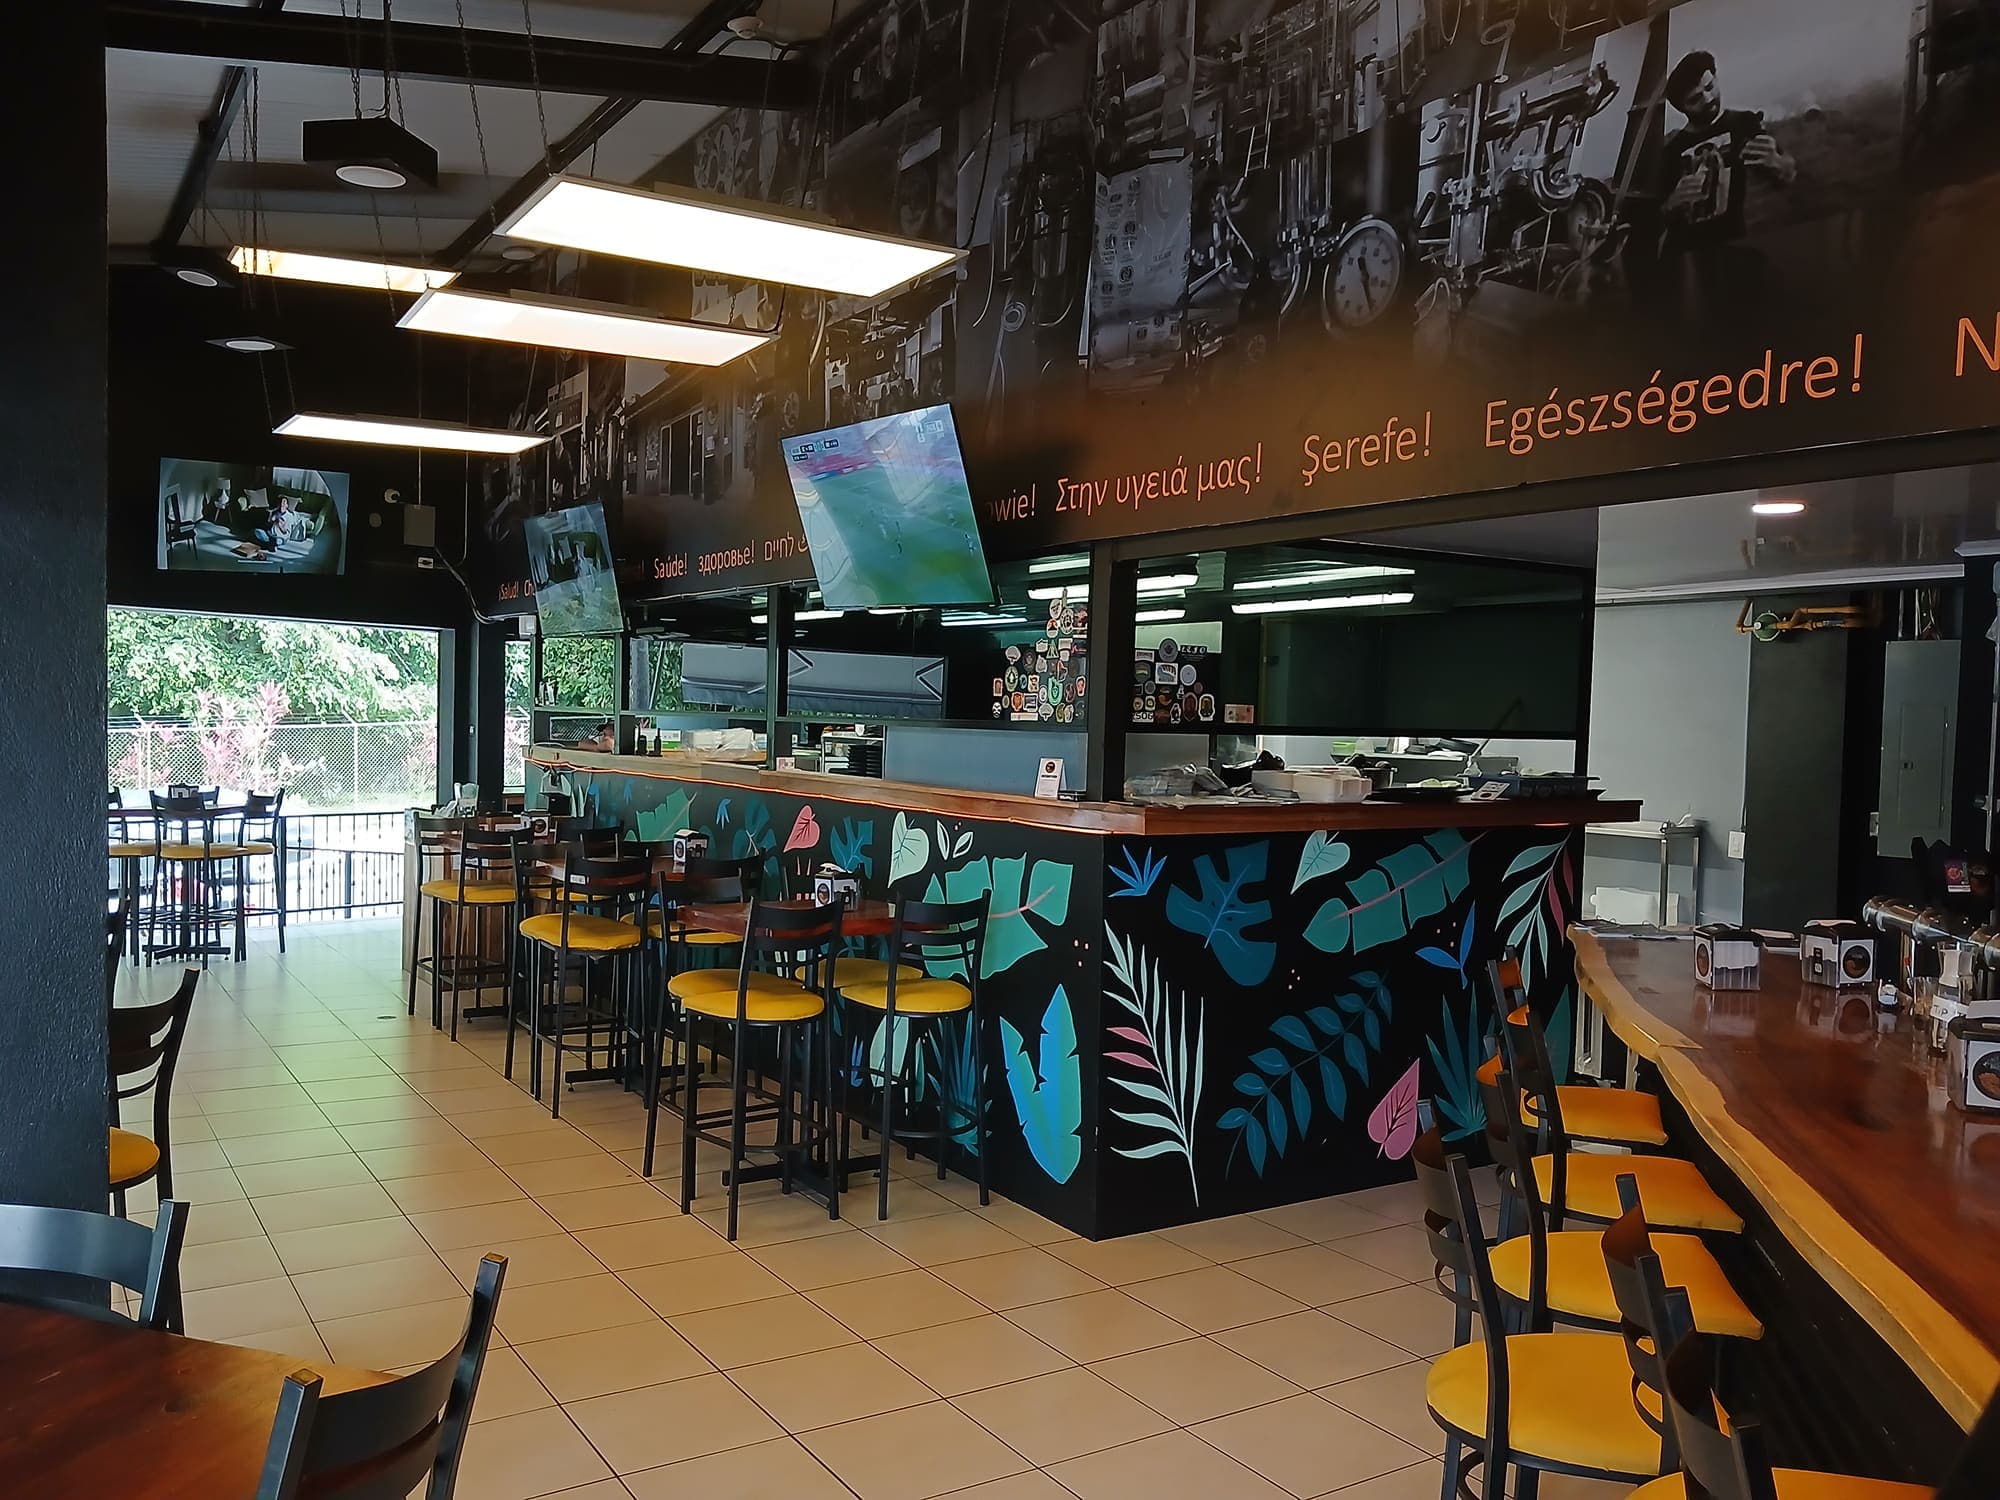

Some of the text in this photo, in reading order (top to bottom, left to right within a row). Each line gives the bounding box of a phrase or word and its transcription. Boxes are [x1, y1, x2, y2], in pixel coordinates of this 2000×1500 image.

[1955, 311, 2000, 378] N
[1484, 333, 1864, 457] Egészségedre!
[1056, 442, 1269, 517] Στην υγειά μας!
[1302, 410, 1431, 487] Şerefe!
[653, 552, 688, 580] Saúde!
[698, 539, 755, 577] здоровье!
